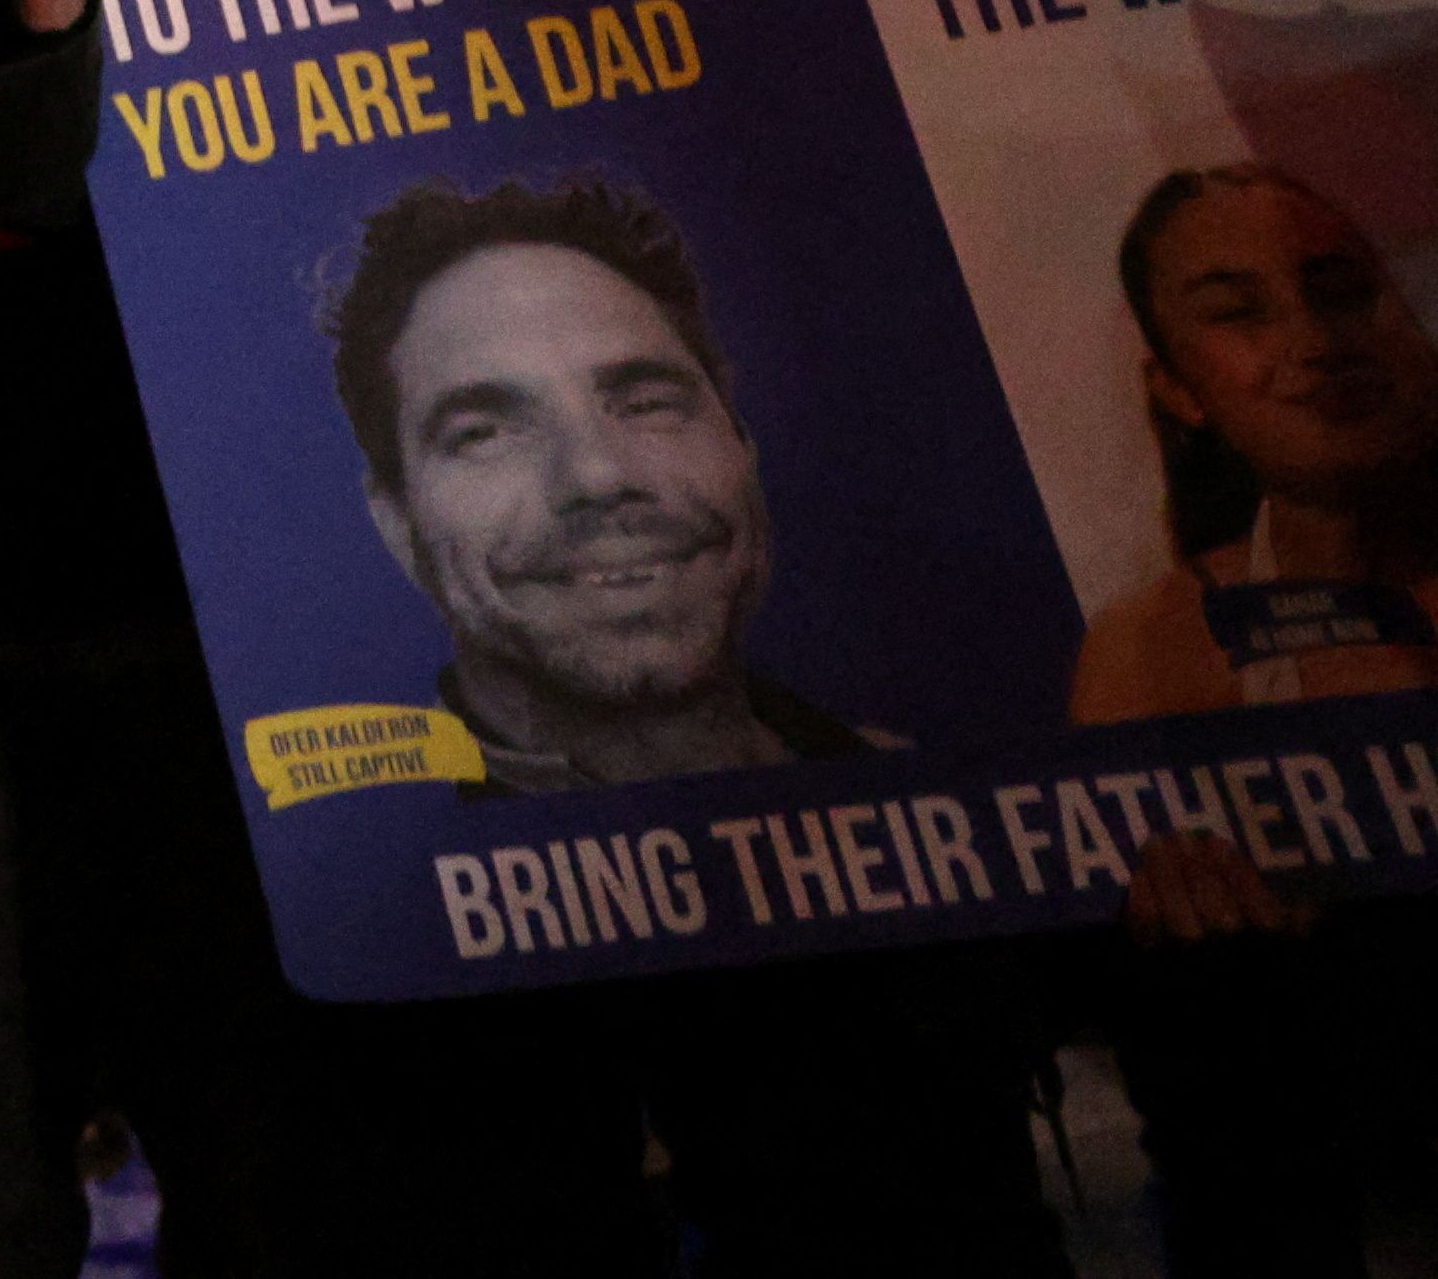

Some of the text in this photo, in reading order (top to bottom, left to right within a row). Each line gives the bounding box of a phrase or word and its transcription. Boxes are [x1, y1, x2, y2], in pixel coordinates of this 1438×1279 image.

[113, 69, 276, 180] YOU
[294, 39, 451, 153] ARE
[463, 29, 526, 122] A
[344, 746, 429, 781] CAPTIVE
[434, 829, 708, 961] BRING
[709, 803, 994, 926] THEIR
